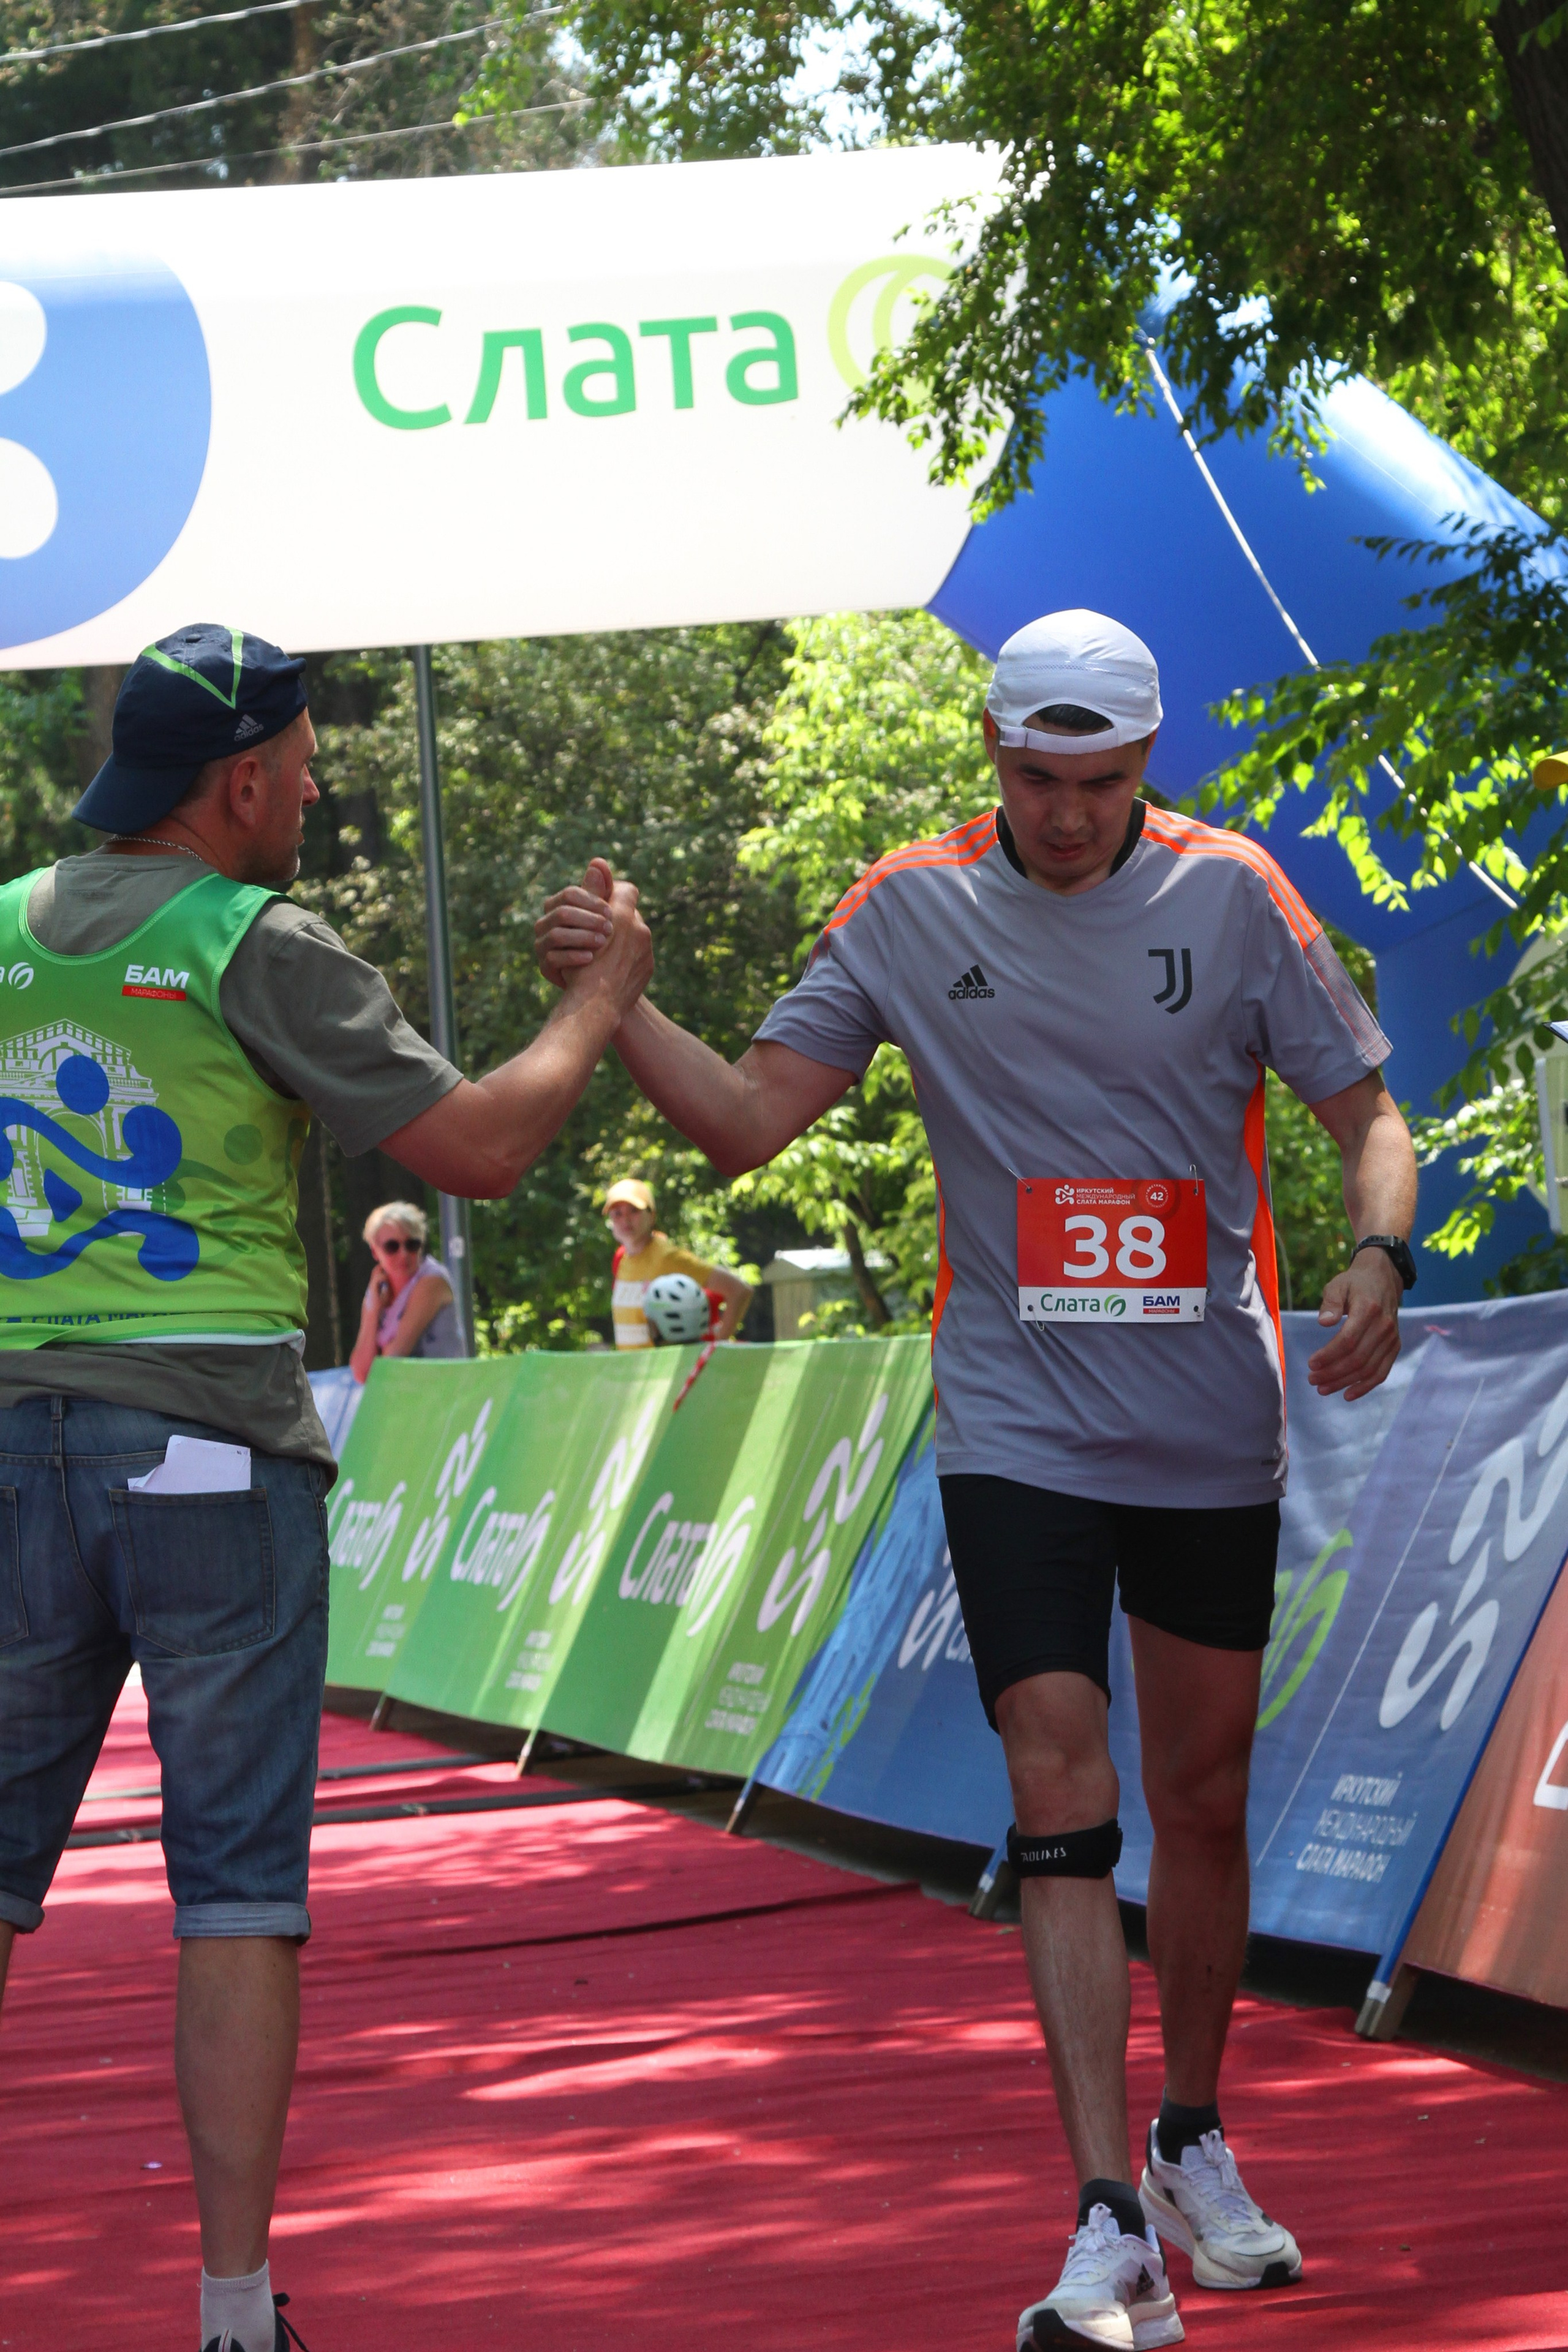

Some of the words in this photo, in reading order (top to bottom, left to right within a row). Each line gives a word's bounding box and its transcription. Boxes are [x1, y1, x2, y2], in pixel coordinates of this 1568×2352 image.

[353, 305, 799, 430] Слата
[234, 723, 264, 742] adidas
[124, 964, 190, 989] БАМ
[130, 987, 176, 1000] МАРАФОНЫ
[948, 986, 995, 1000] adidas
[1150, 1192, 1164, 1200] 42
[1063, 1215, 1167, 1280] 38
[1041, 1294, 1100, 1312] Слата
[1143, 1295, 1180, 1306] БАМ
[619, 1491, 718, 1608] Слата
